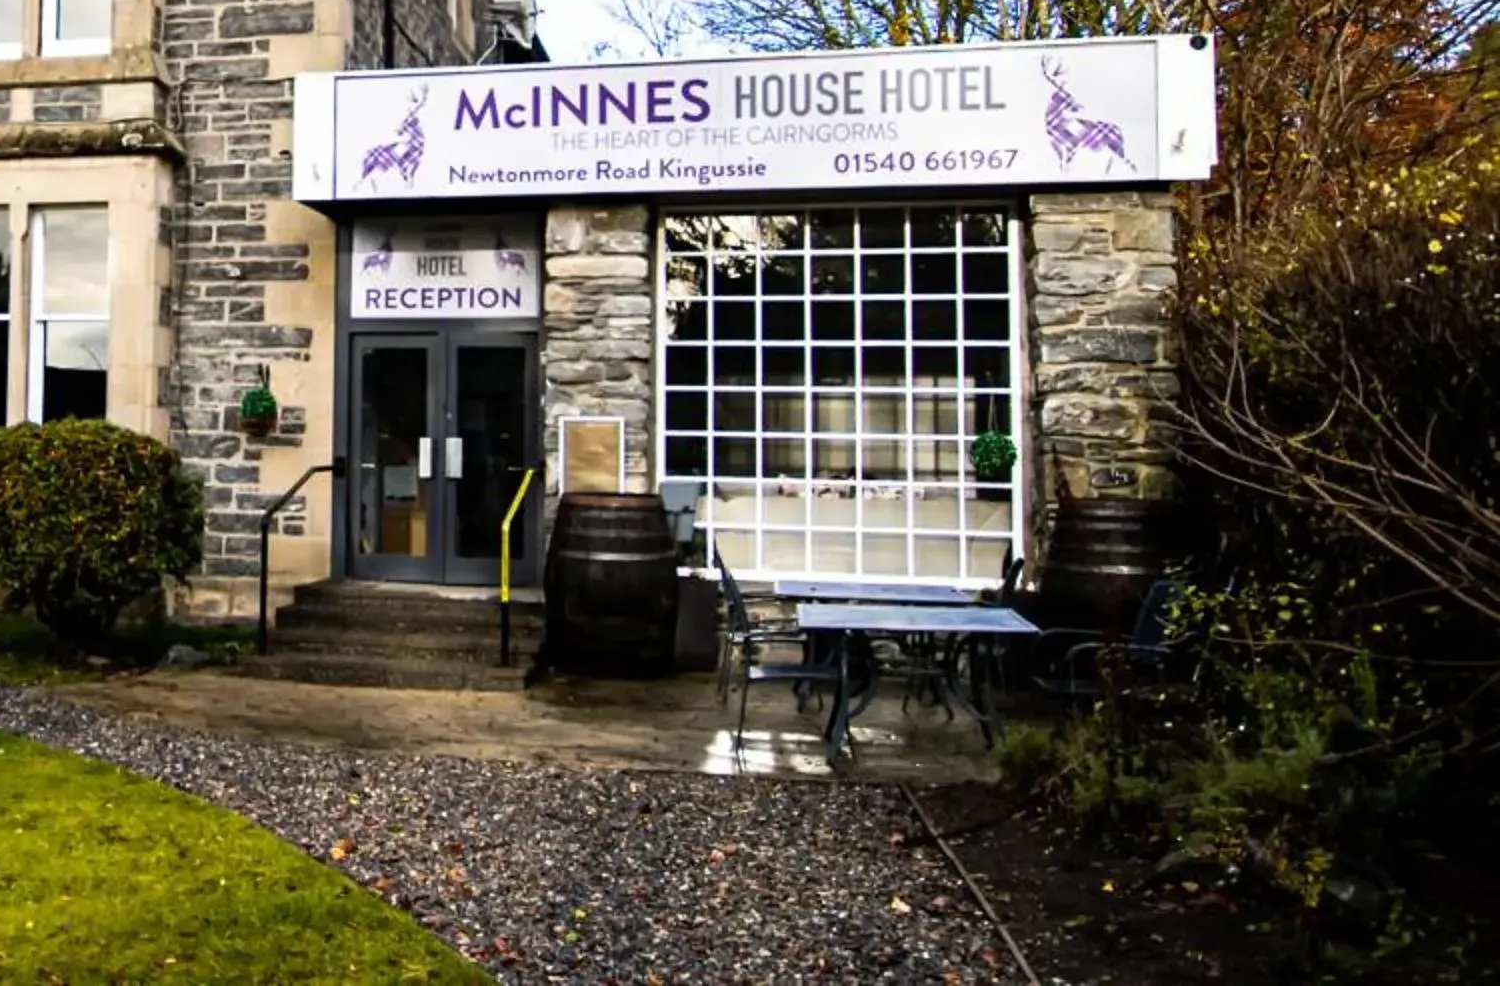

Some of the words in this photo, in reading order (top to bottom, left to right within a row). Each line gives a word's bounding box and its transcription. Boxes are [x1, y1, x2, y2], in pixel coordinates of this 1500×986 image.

[454, 79, 711, 130] McINNES
[735, 71, 865, 118] HOUSE
[880, 65, 1007, 114] HOTEL
[551, 131, 588, 151] THE
[594, 129, 660, 150] HEART
[666, 127, 697, 148] OF
[702, 125, 741, 147] THE
[746, 121, 899, 145] CAIRNGORMS
[449, 164, 587, 185] Newtonmore
[595, 159, 650, 181] Road
[659, 157, 767, 185] Kingussie
[834, 151, 915, 174] 01540
[925, 149, 1019, 172] 661967
[416, 256, 468, 276] HOTEL
[365, 287, 521, 309] RECEPTION
